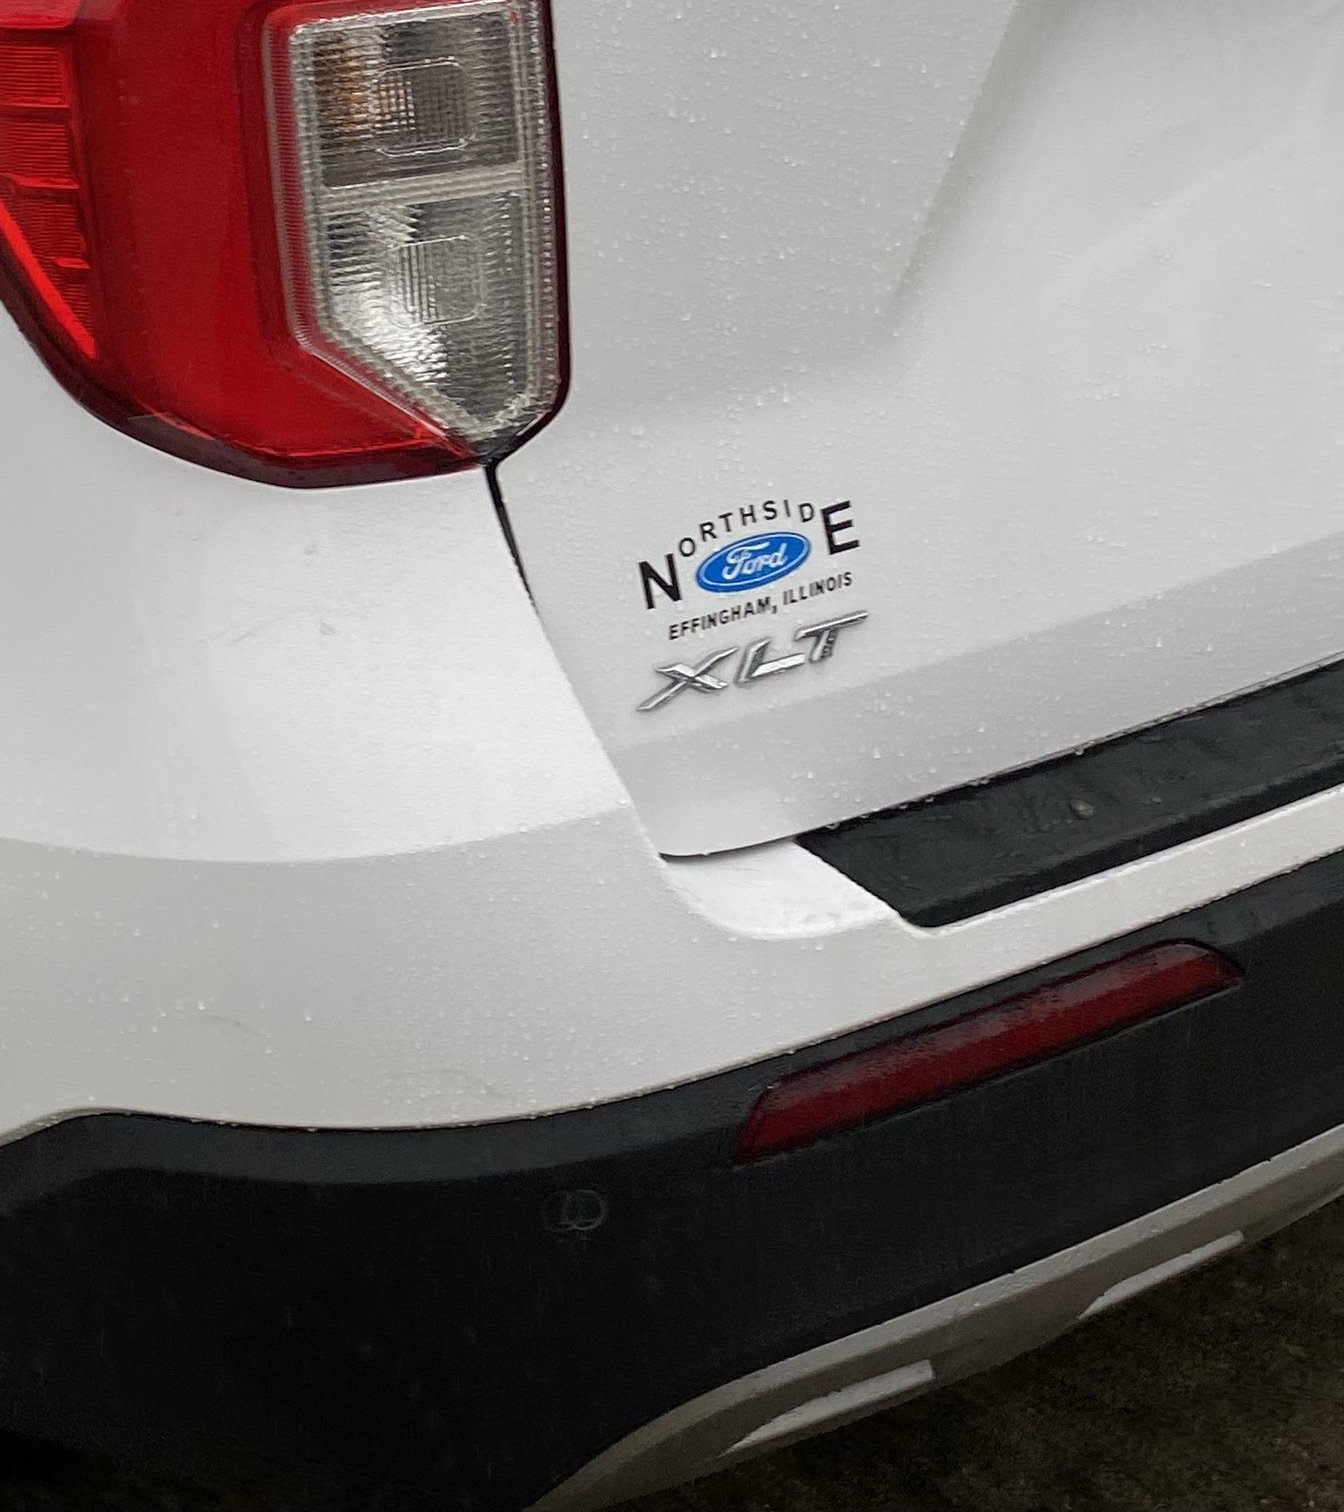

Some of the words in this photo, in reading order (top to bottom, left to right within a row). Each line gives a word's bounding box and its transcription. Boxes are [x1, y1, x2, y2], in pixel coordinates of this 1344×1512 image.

[637, 499, 861, 610] NORTHSIDE
[721, 540, 789, 581] Ford
[667, 595, 779, 641] EFFINGHAM,
[782, 571, 854, 607] ILLINOIS
[635, 608, 870, 713] XLT
